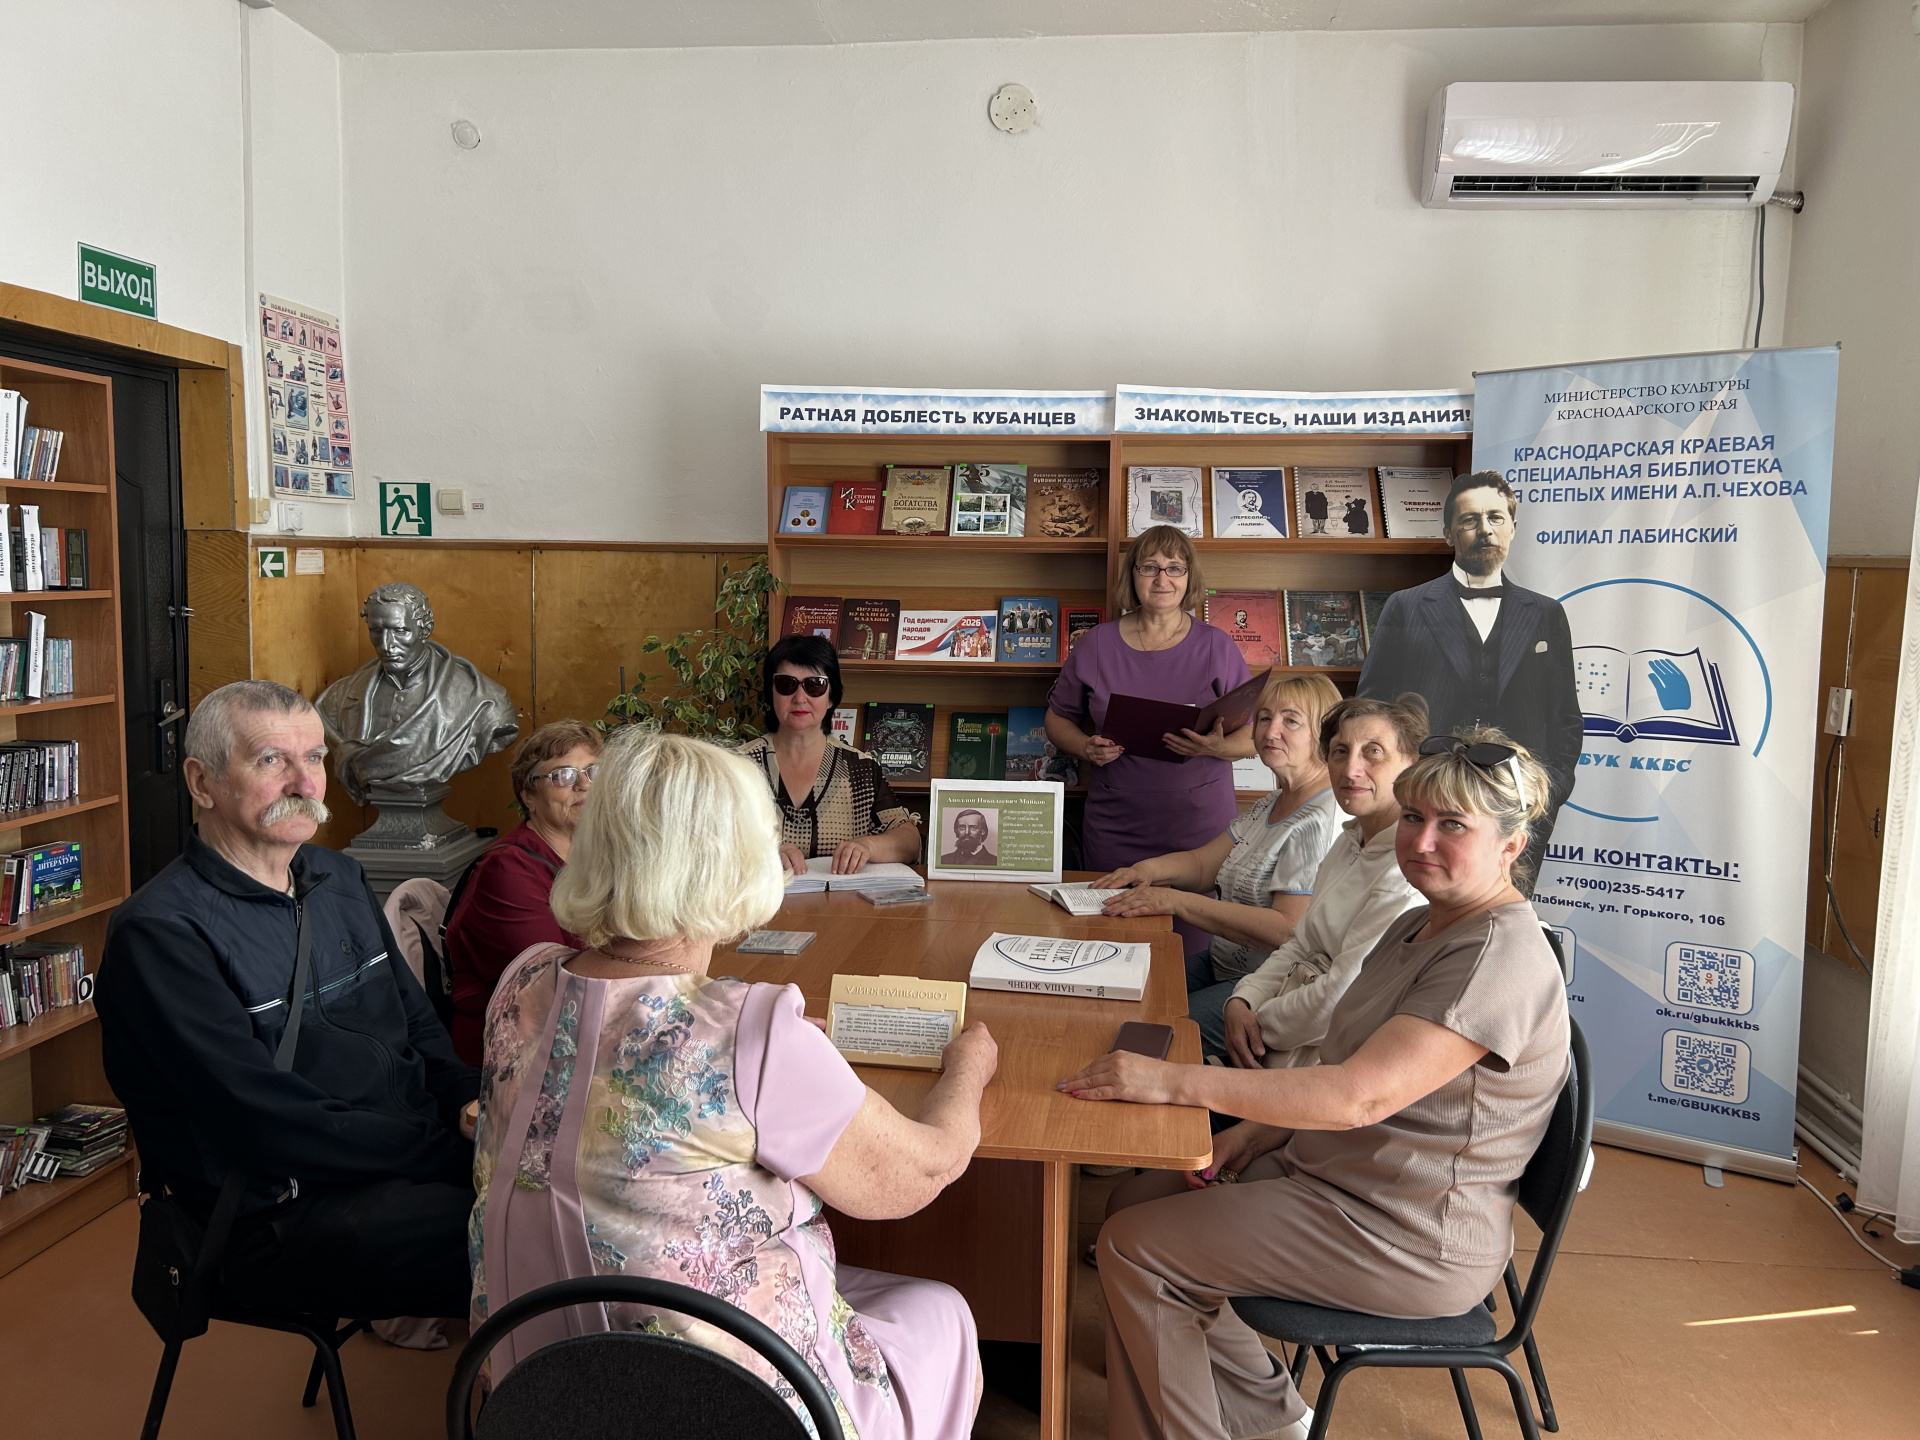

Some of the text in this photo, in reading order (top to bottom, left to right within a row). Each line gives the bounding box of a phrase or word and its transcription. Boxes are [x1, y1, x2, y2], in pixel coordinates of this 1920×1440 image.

[83, 261, 153, 308] ВЫХОД
[270, 303, 297, 316] ПОЖАРНАЯ
[1544, 379, 1750, 404] МИНИСТЕРСТВО КУЛЬТУРЫ
[779, 407, 1076, 427] РАТНАЯ ДОБЛЕСТЬ КУБАНЦЕВ
[1134, 407, 1471, 428] ЗНАКОМЬТЕСЬ, НАШИ ИЗДАНИЯ!
[1557, 398, 1737, 421] КРАСНОДАРСКОГО КРАЯ
[1514, 435, 1775, 462] КРАСНОДАРСКАЯ КРАЕВАЯ
[1505, 458, 1783, 484] СПЕЦИАЛЬНАЯ БИБЛИОТЕКА
[1528, 486, 1605, 503] СЛЕПЫХ
[1610, 484, 1678, 501] ИМЕНИ
[1683, 479, 1808, 500] А.П.ЧЕХОВА
[893, 499, 938, 507] БОГАТСТВА
[1536, 523, 1738, 545] ФИЛИАЛ ЛАБИНСКИЙ
[903, 616, 915, 624] Год
[1578, 754, 1692, 772] БУК ККБС
[1545, 843, 1739, 878] ши контакты:
[1556, 875, 1685, 900] +7(900)235-5417
[1532, 893, 1726, 926] Лабинск, ул. Горького, 106
[846, 985, 949, 1001] ГОВОРЯЩАЯ КНИГА
[1008, 980, 1075, 993] НАША ЖИЗНЬ
[1656, 1007, 1760, 1032] ok.ru/gbukkkbs
[1647, 1092, 1761, 1122] t.me/GBUKKKBS
